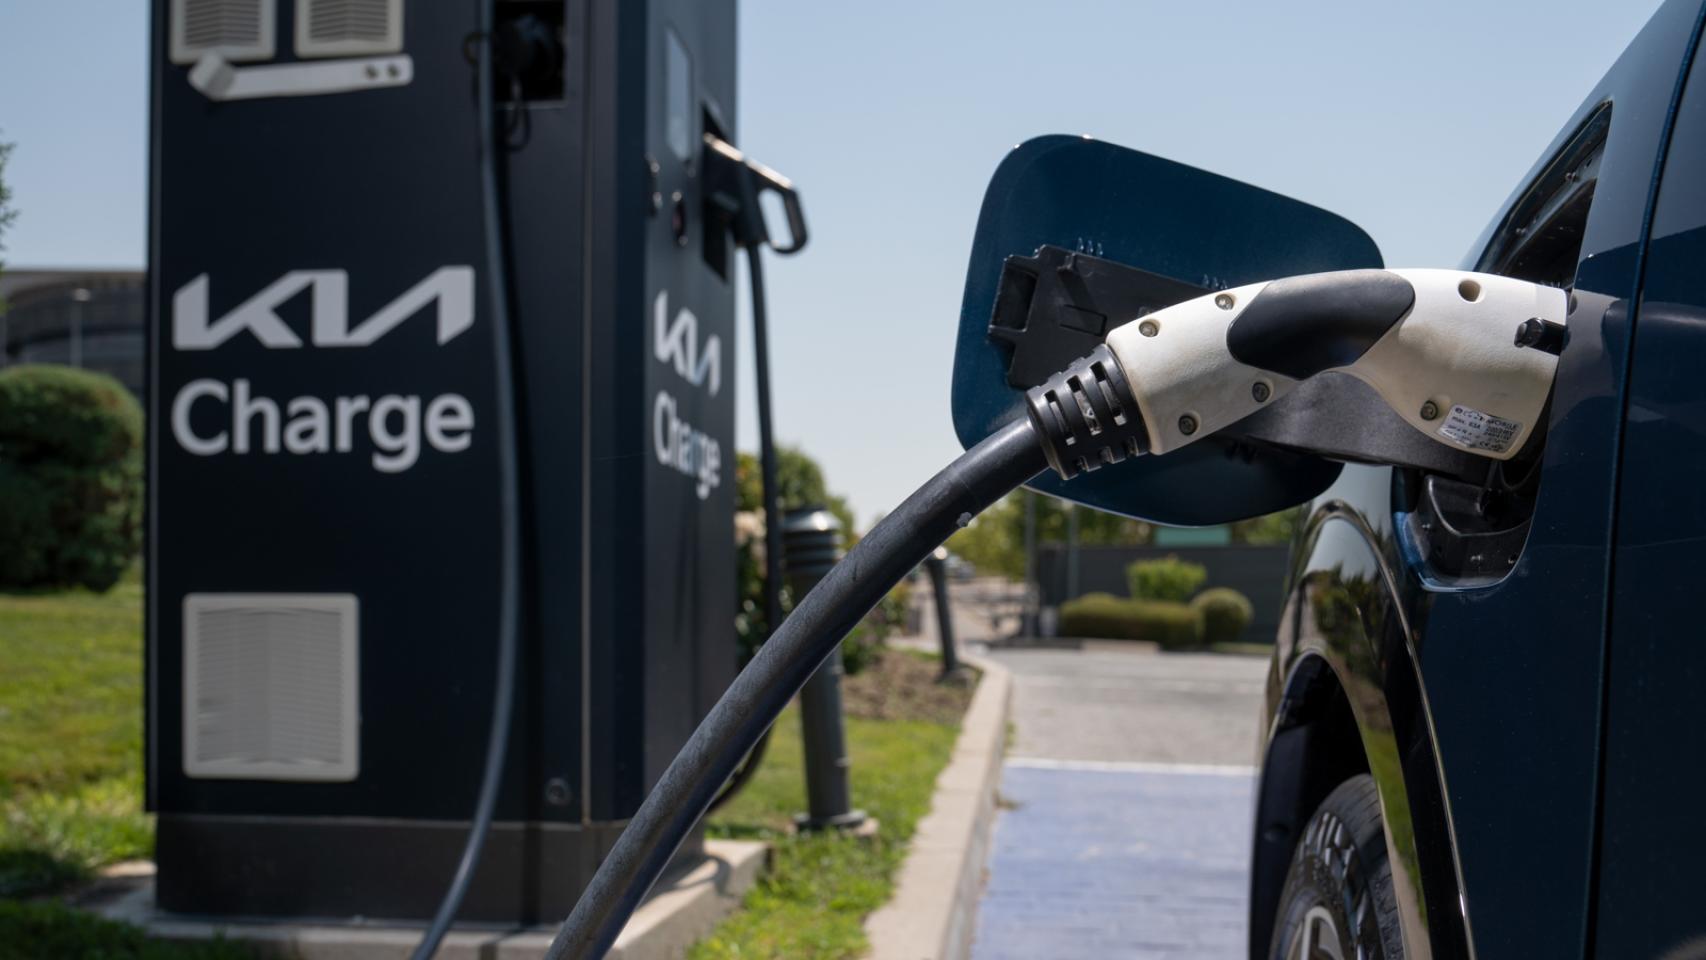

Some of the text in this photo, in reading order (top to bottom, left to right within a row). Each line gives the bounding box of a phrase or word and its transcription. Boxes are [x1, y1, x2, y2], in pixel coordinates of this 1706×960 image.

[173, 265, 475, 350] KIA
[654, 290, 721, 397] KIA
[172, 380, 474, 472] Charge
[654, 391, 721, 499] Charge
